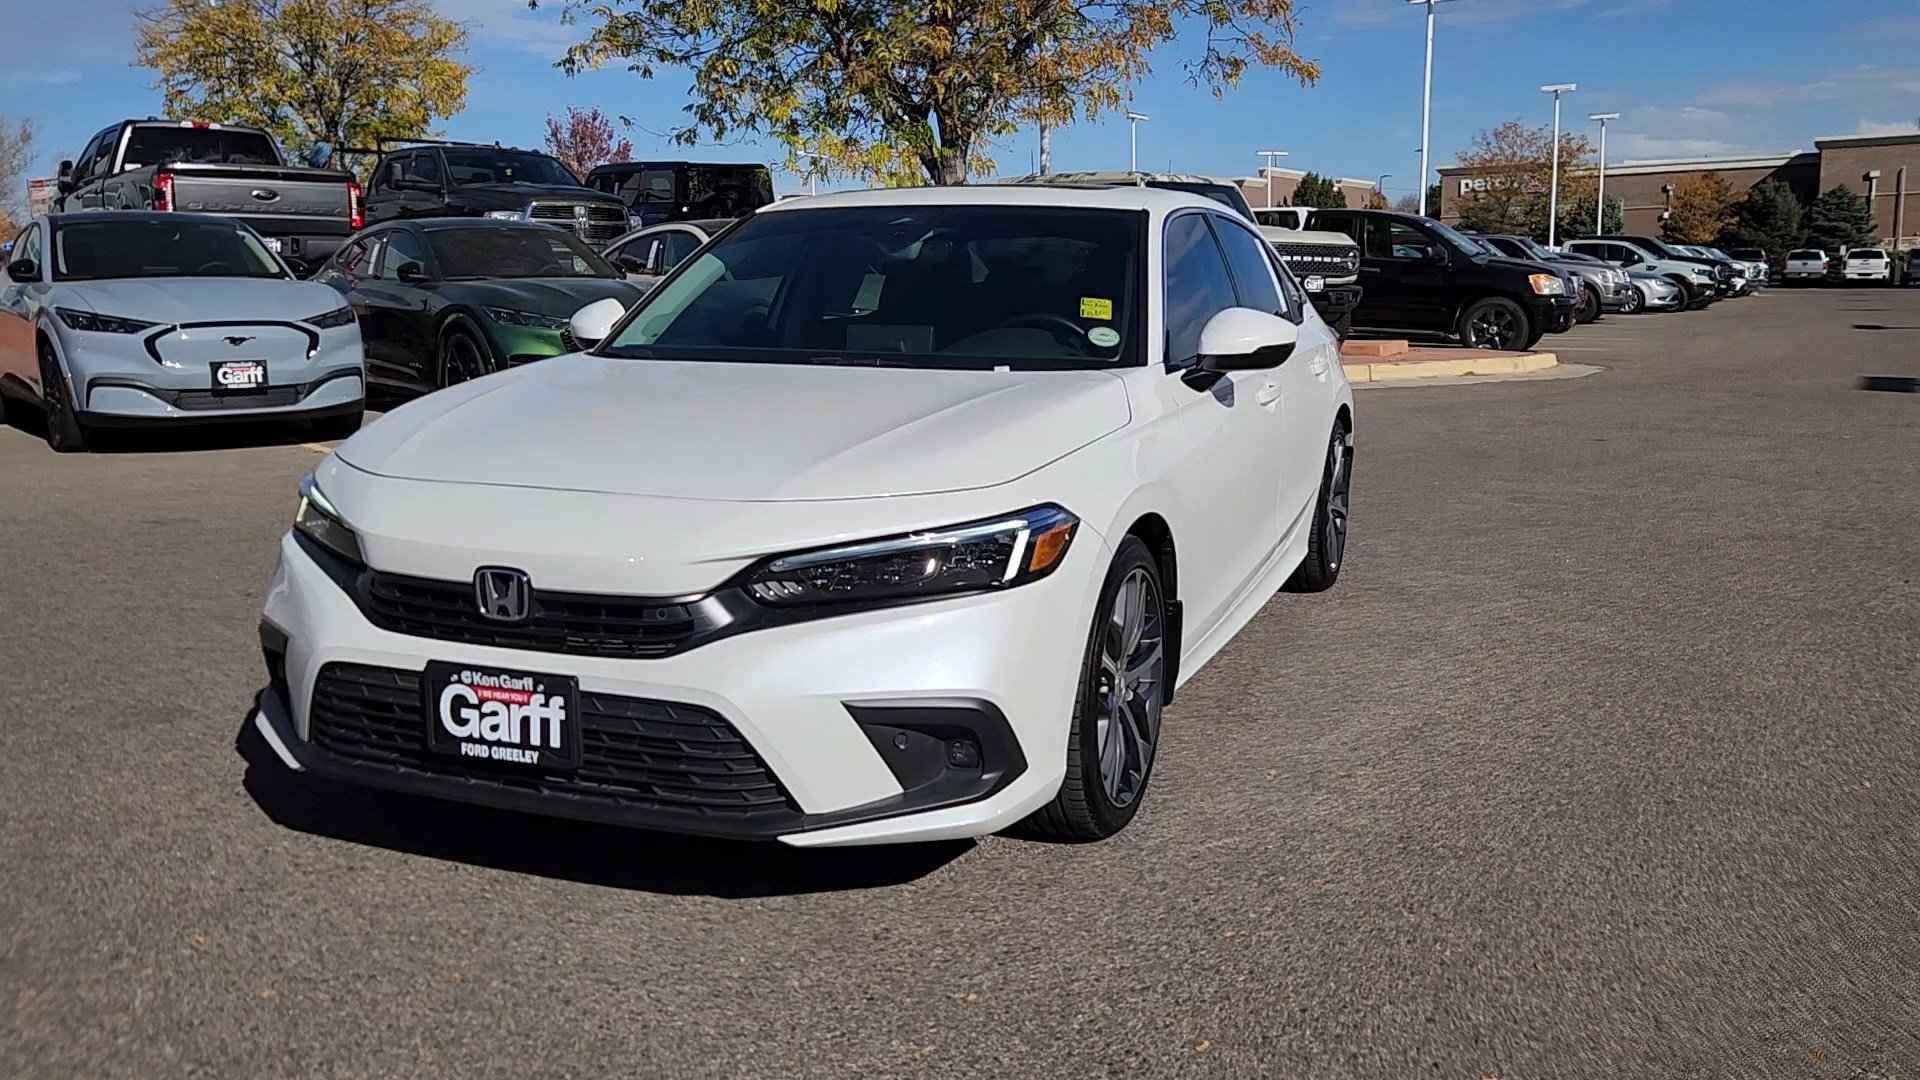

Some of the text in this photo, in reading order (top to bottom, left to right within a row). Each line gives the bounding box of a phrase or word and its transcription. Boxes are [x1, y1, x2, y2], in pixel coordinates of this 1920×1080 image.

[1304, 278, 1325, 291] Garff
[217, 365, 264, 385] Garff
[472, 671, 534, 691] Ken Garff
[493, 690, 510, 701] HEAR
[440, 683, 566, 748] Garff
[461, 742, 539, 764] FORD GREELEY
